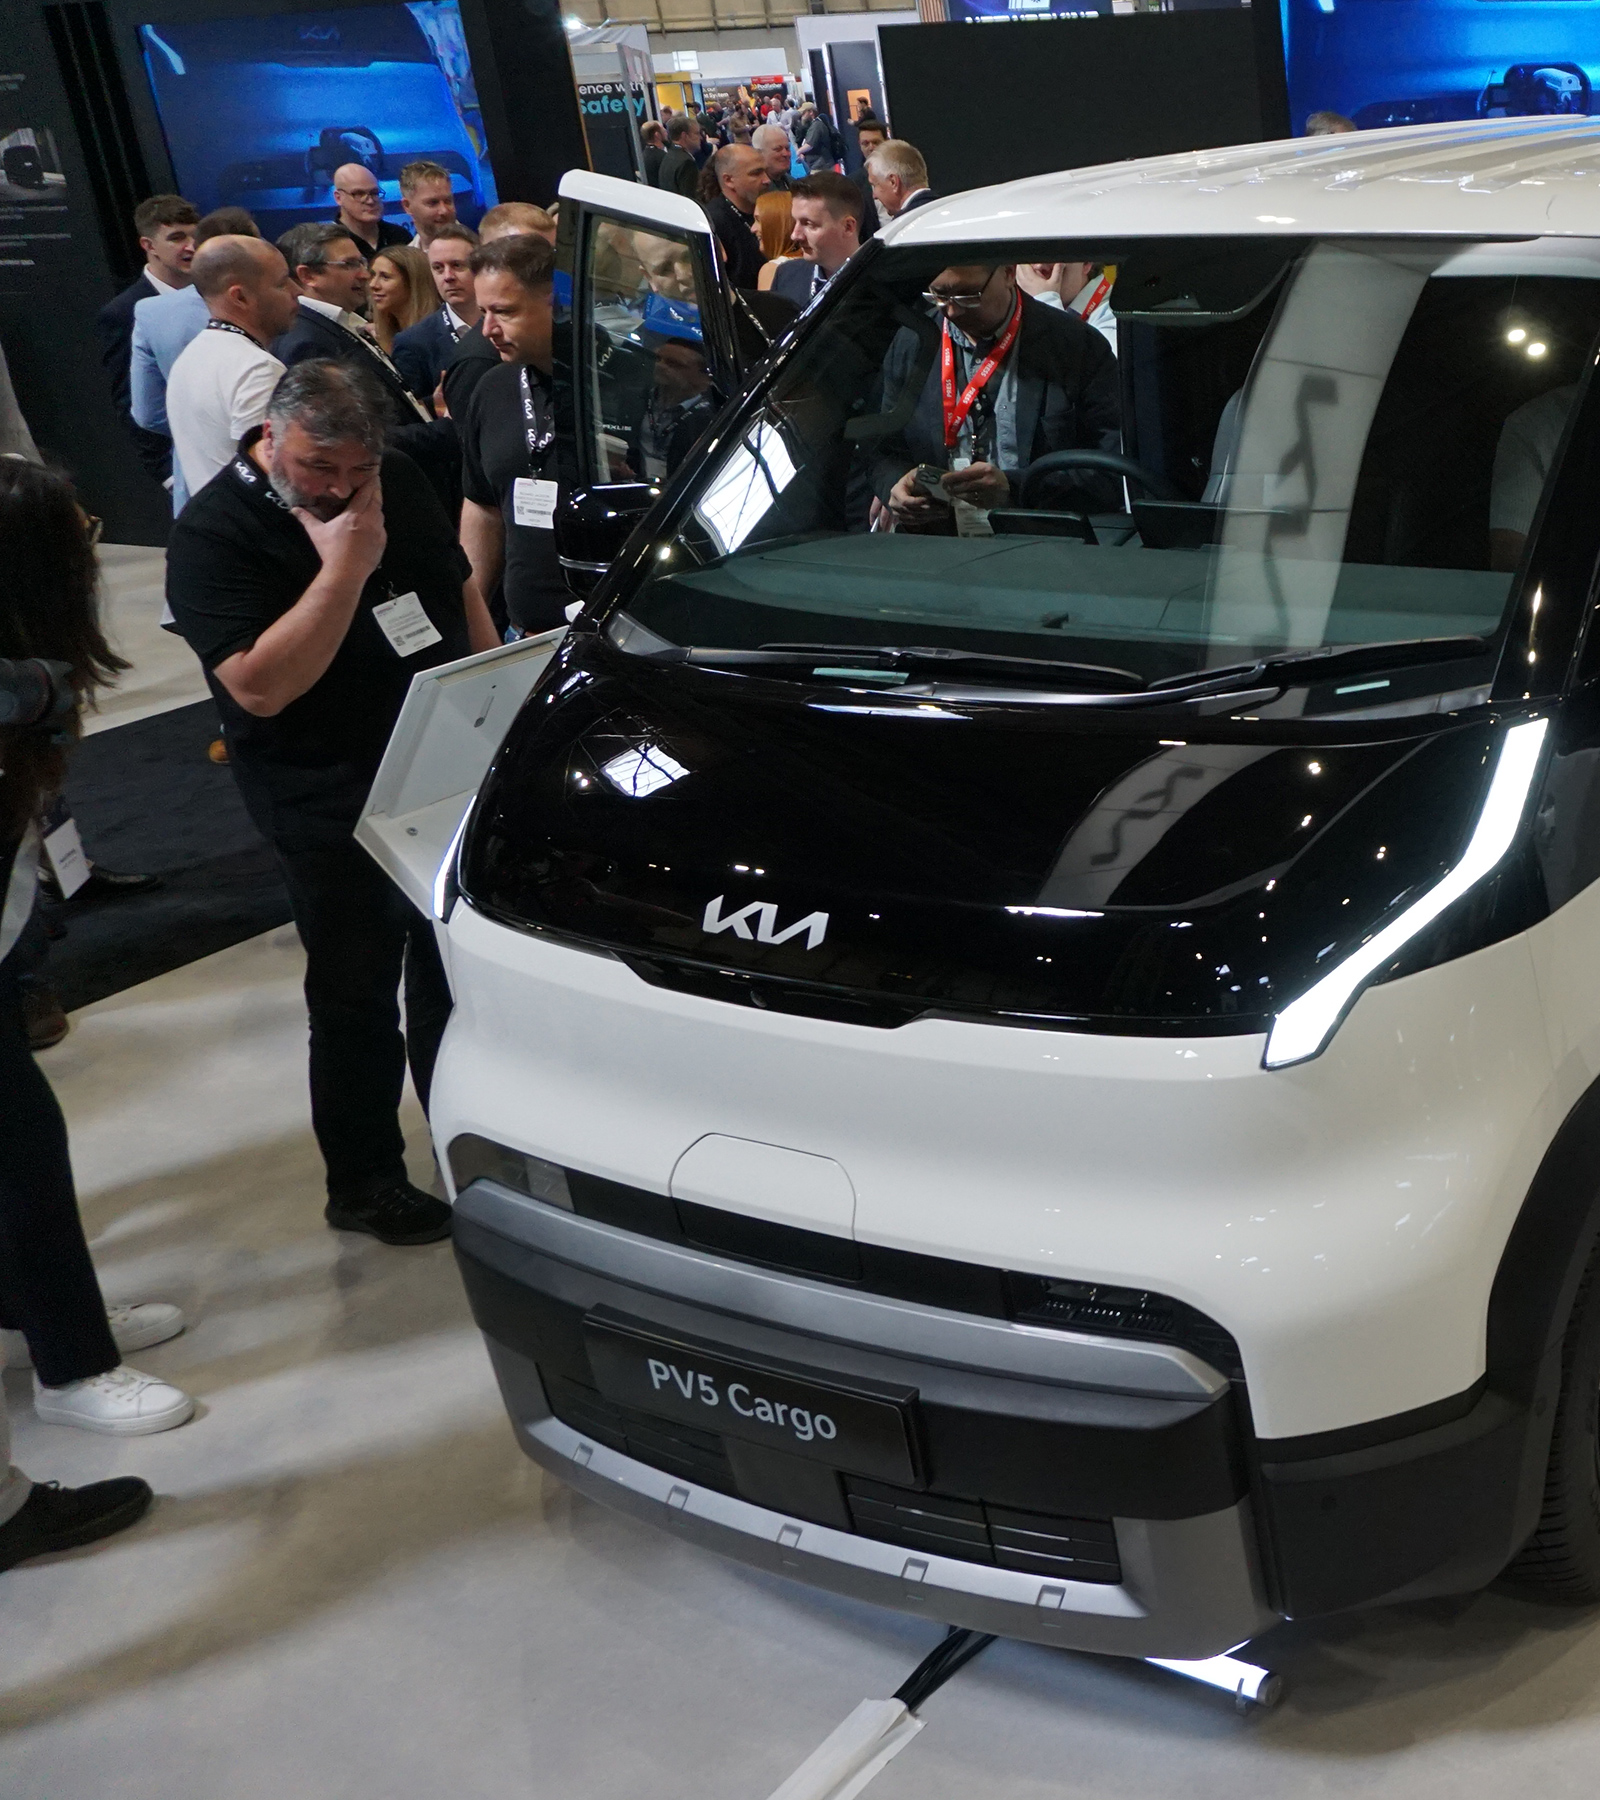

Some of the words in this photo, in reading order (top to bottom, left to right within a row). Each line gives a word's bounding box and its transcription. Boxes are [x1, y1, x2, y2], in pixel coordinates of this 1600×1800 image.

[615, 80, 645, 93] wth
[980, 359, 996, 378] PRESS
[962, 386, 977, 405] PRESS
[235, 461, 258, 483] KIA
[702, 894, 830, 951] KIA
[647, 1358, 719, 1407] PV5
[727, 1382, 838, 1441] Cargo
